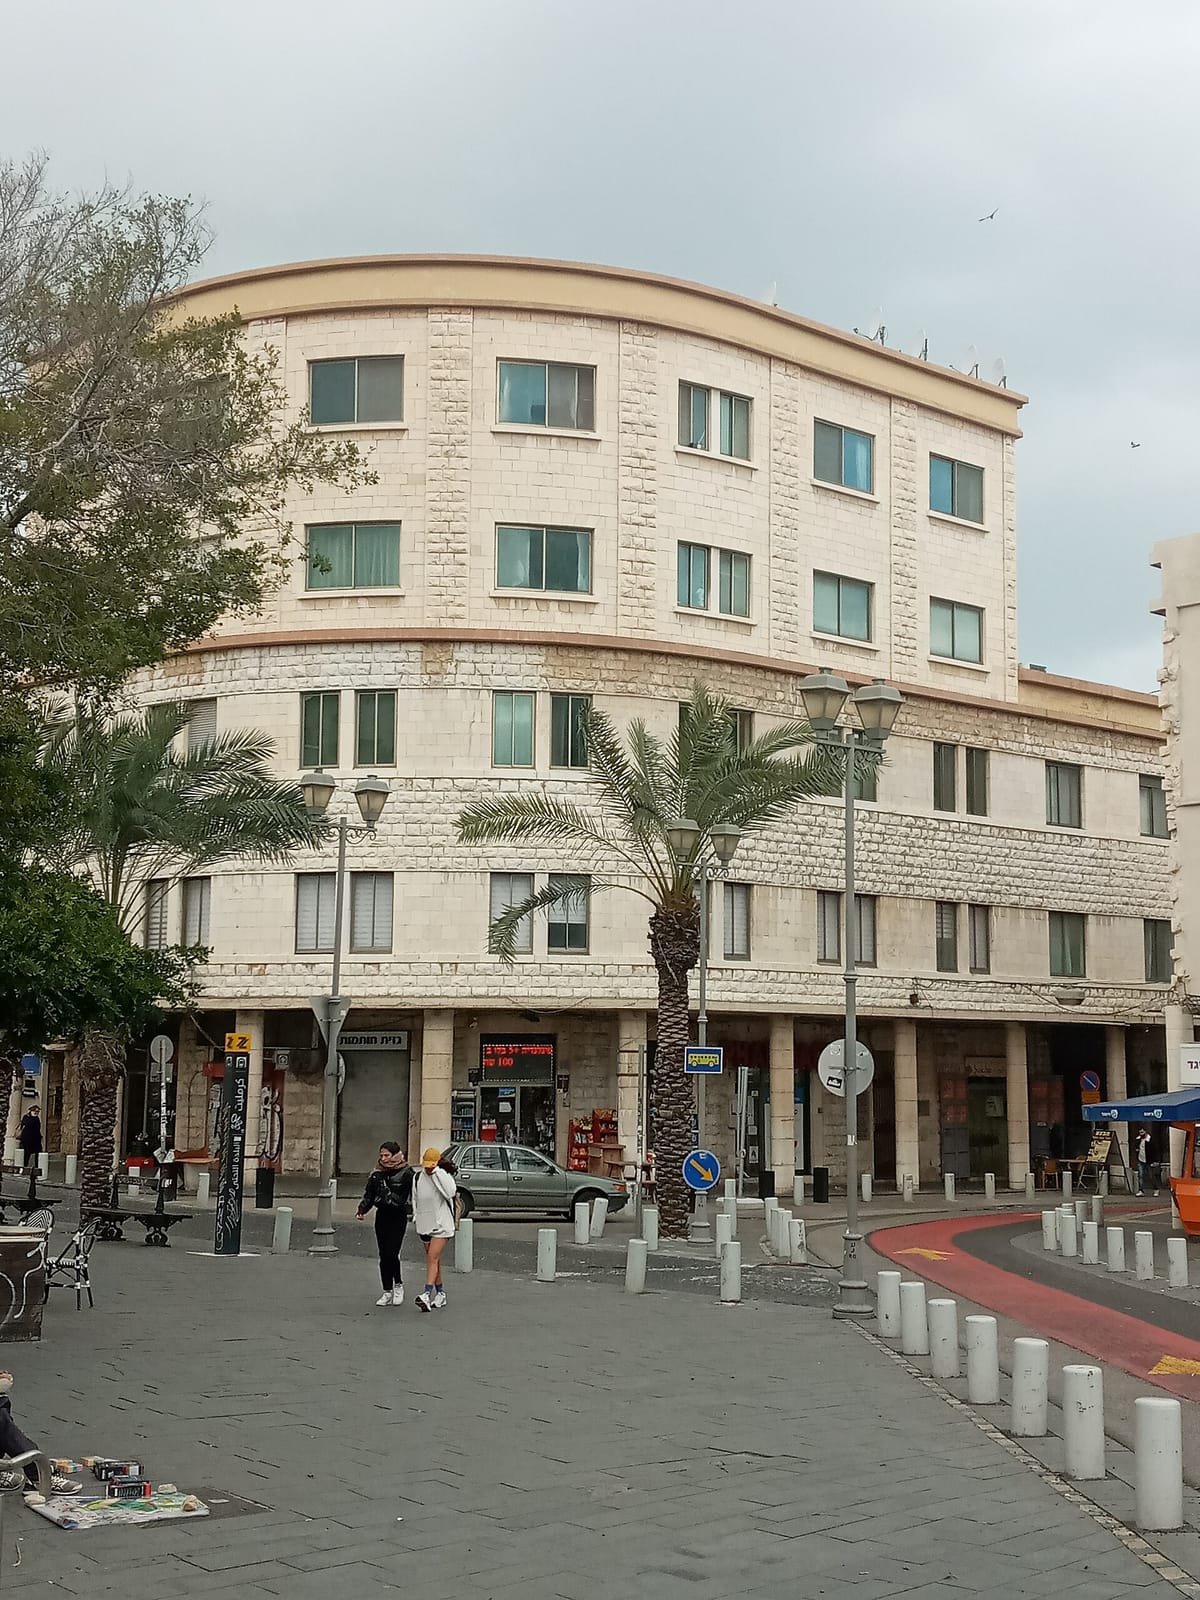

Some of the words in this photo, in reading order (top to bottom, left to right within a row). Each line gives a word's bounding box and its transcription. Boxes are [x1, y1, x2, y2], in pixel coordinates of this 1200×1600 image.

[340, 1036, 378, 1045] חותמות
[499, 1057, 514, 1066] 100
[235, 1078, 247, 1111] كرمليت
